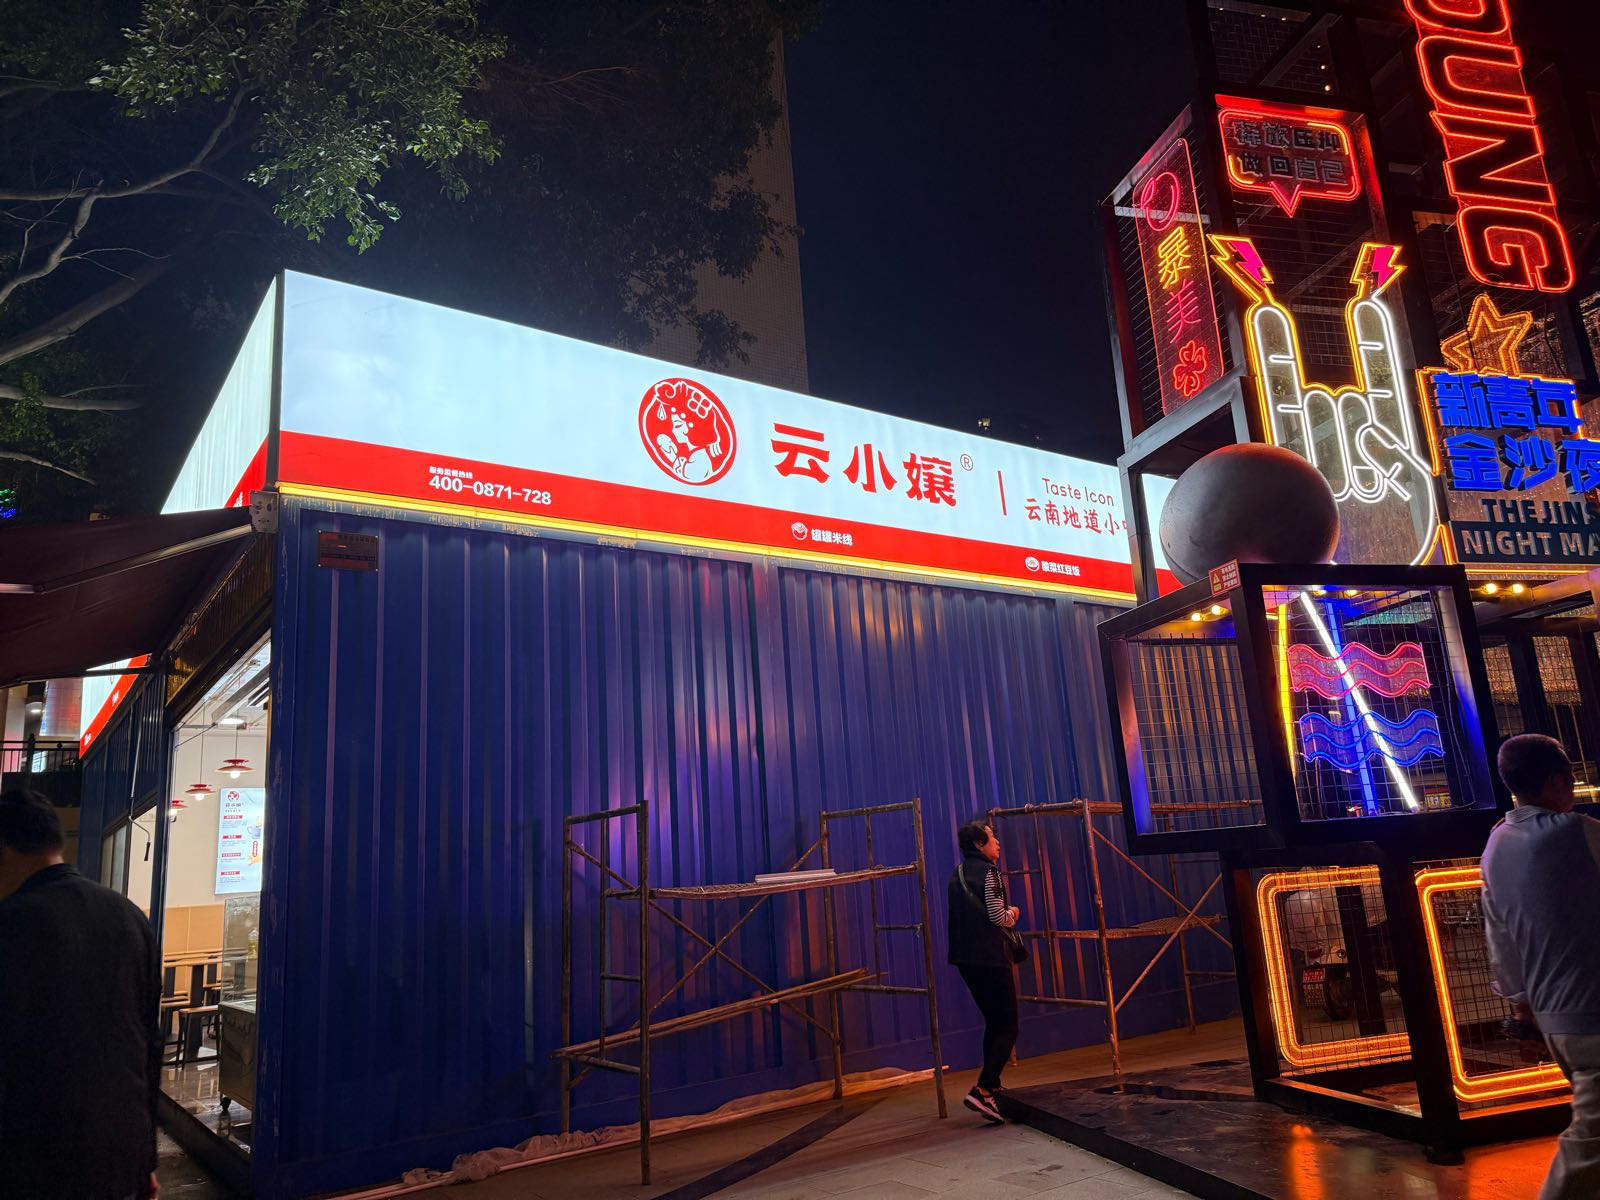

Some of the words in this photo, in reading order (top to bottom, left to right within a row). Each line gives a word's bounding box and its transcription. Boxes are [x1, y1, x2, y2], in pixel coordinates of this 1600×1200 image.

[1431, 372, 1583, 432] 新青年
[771, 423, 957, 507] 云小嬢
[429, 475, 552, 505] 400-0871-728
[1042, 477, 1081, 500] Taste
[1084, 486, 1114, 507] Icon
[1481, 498, 1538, 524] THE
[1460, 529, 1552, 556] NIGHT
